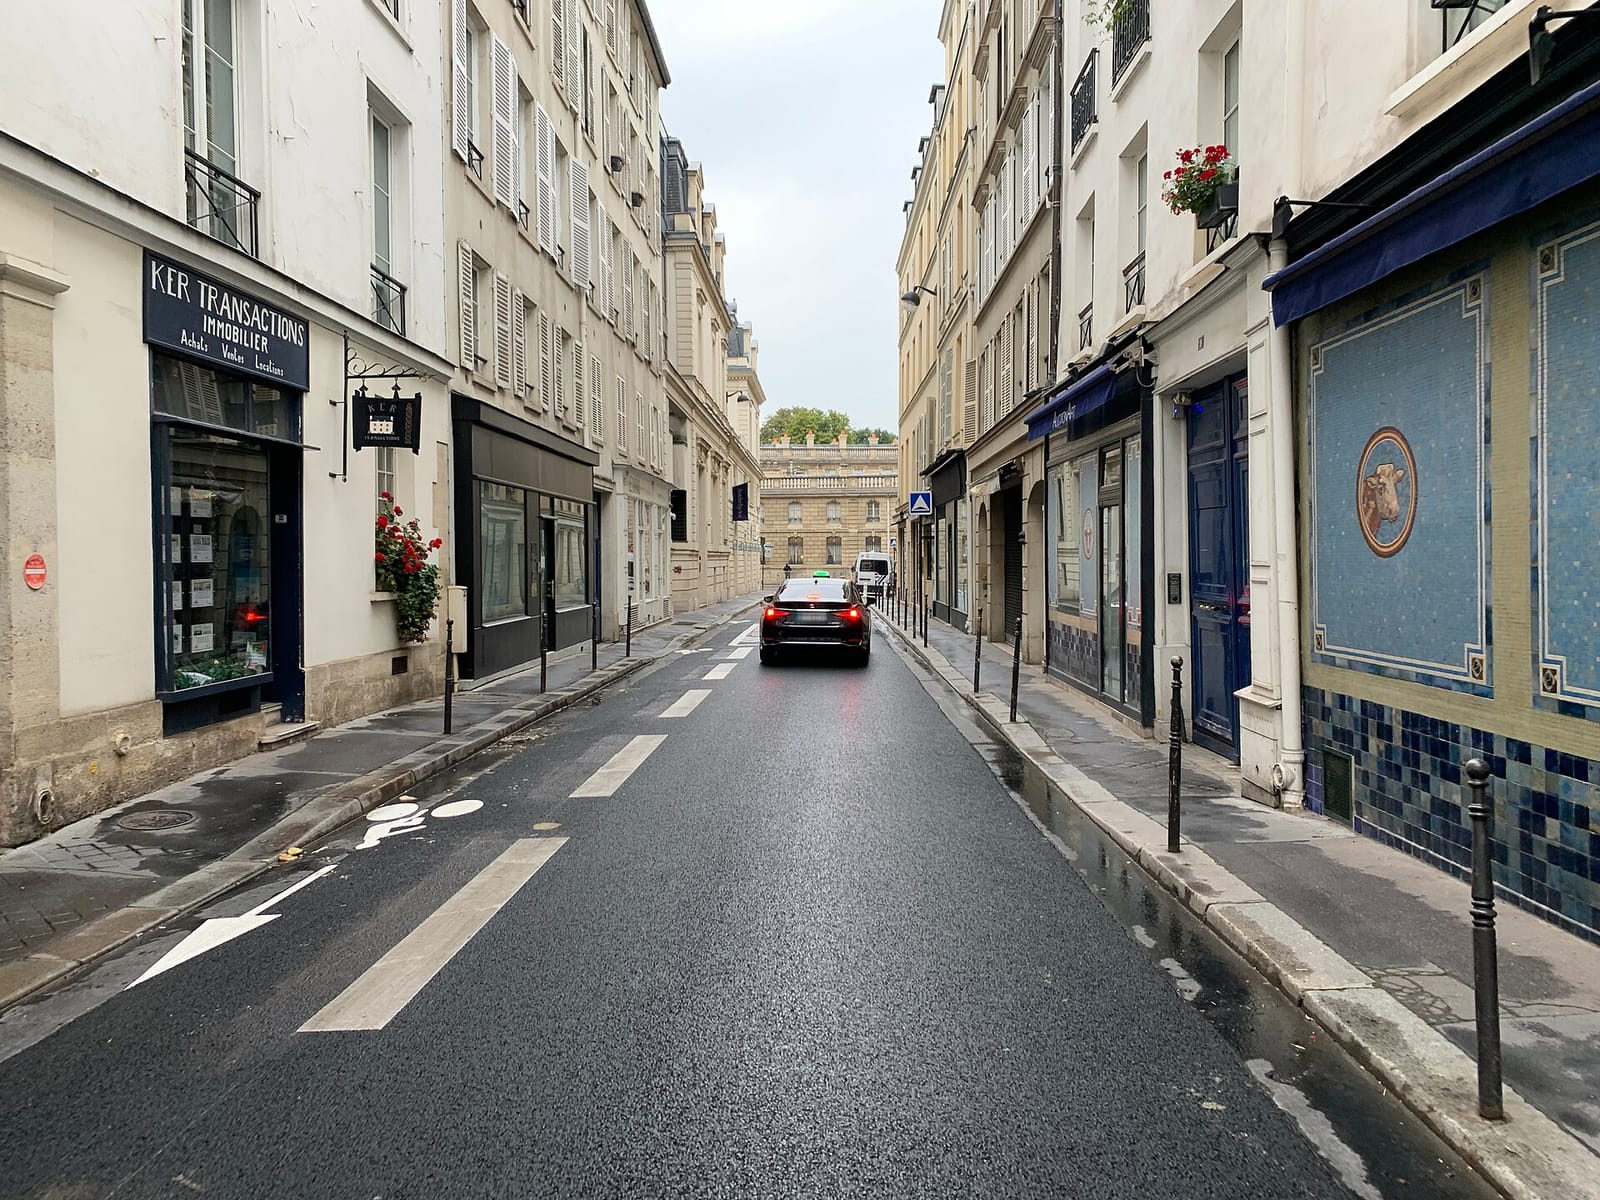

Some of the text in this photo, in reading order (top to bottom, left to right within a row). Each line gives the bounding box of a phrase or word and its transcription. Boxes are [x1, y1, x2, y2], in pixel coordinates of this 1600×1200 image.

[151, 260, 305, 347] KER TRANSACTIONS
[180, 329, 284, 376] Achats Ventes Locations
[203, 315, 269, 353] IMMOBILIER
